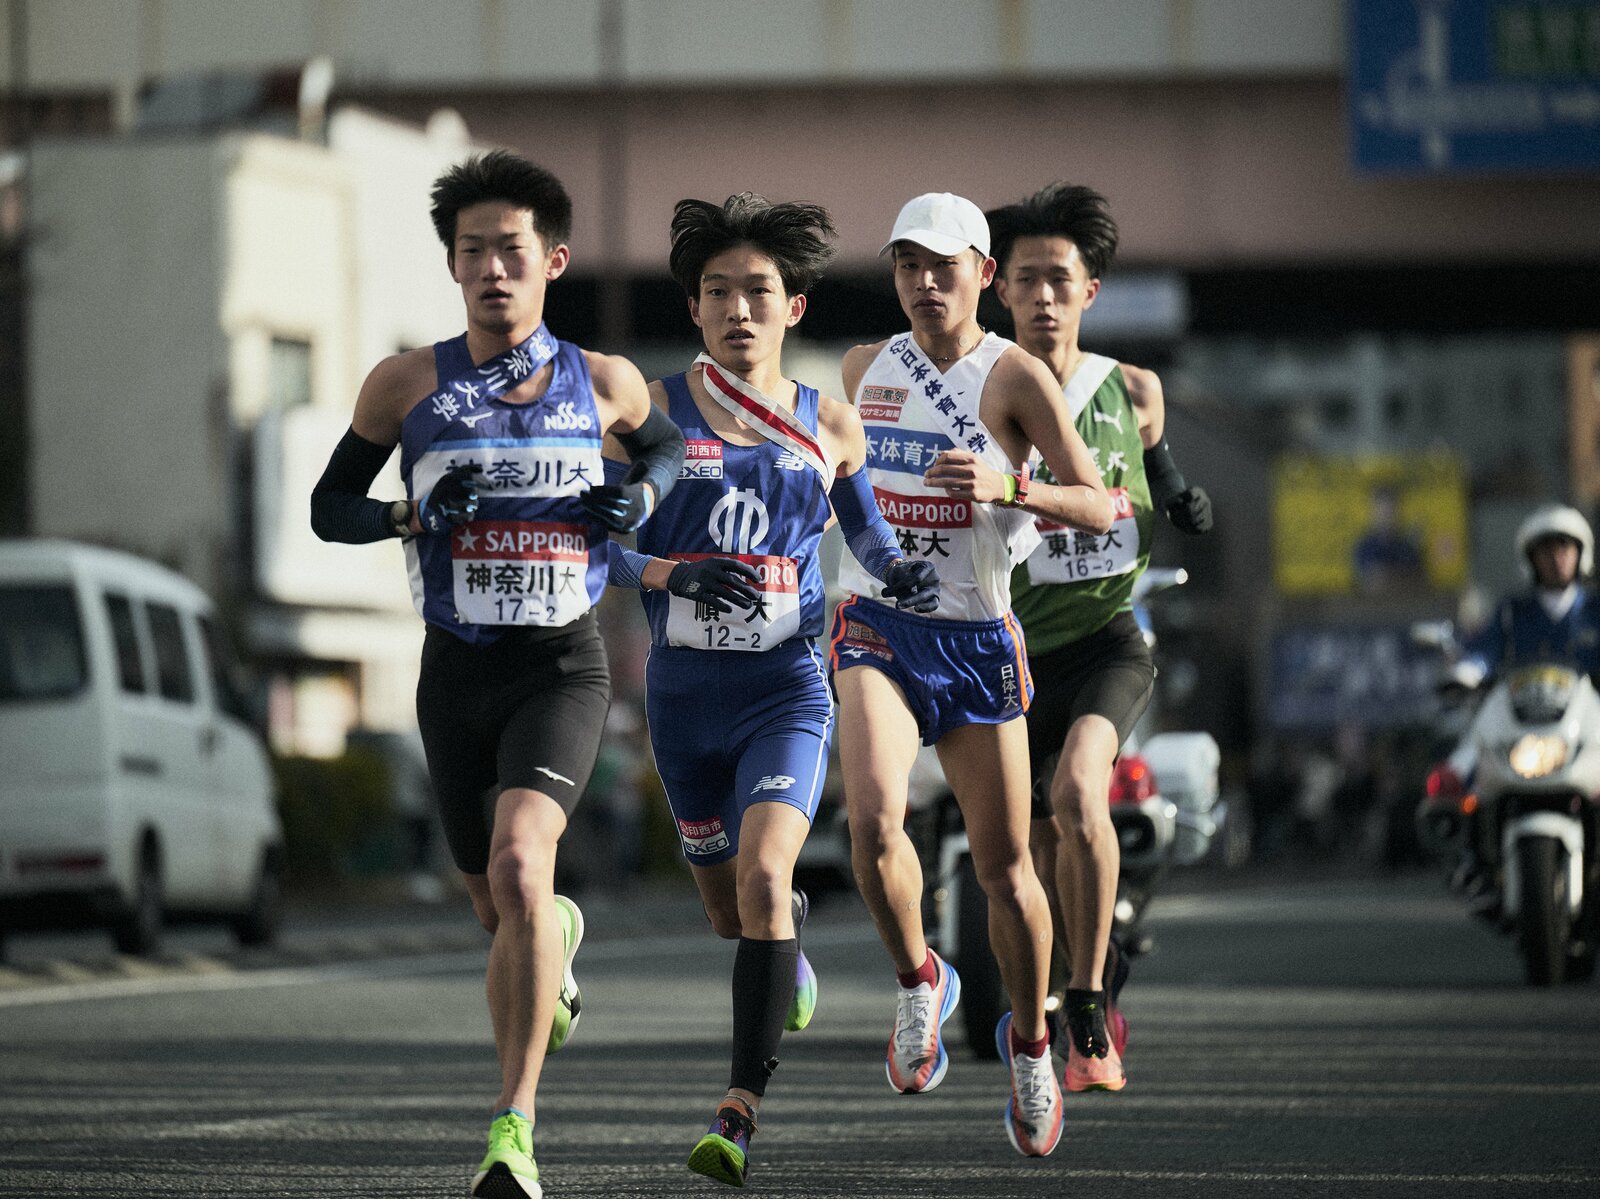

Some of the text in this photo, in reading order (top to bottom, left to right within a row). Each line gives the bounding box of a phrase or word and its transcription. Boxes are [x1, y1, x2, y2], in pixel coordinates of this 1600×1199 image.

[432, 333, 553, 422] 神奈川大学
[543, 401, 592, 430] NISSO
[901, 349, 988, 454] 日本体育大学
[686, 444, 722, 457] 印西市
[446, 458, 592, 489] 奈川大
[880, 498, 967, 523] SAPPORO
[485, 530, 585, 557] SAPPORO
[465, 563, 577, 596] 神奈川大
[1065, 558, 1113, 578] 16-2
[495, 598, 556, 623] 17-2
[704, 625, 761, 649] 12-2
[1001, 664, 1019, 708] 日体大
